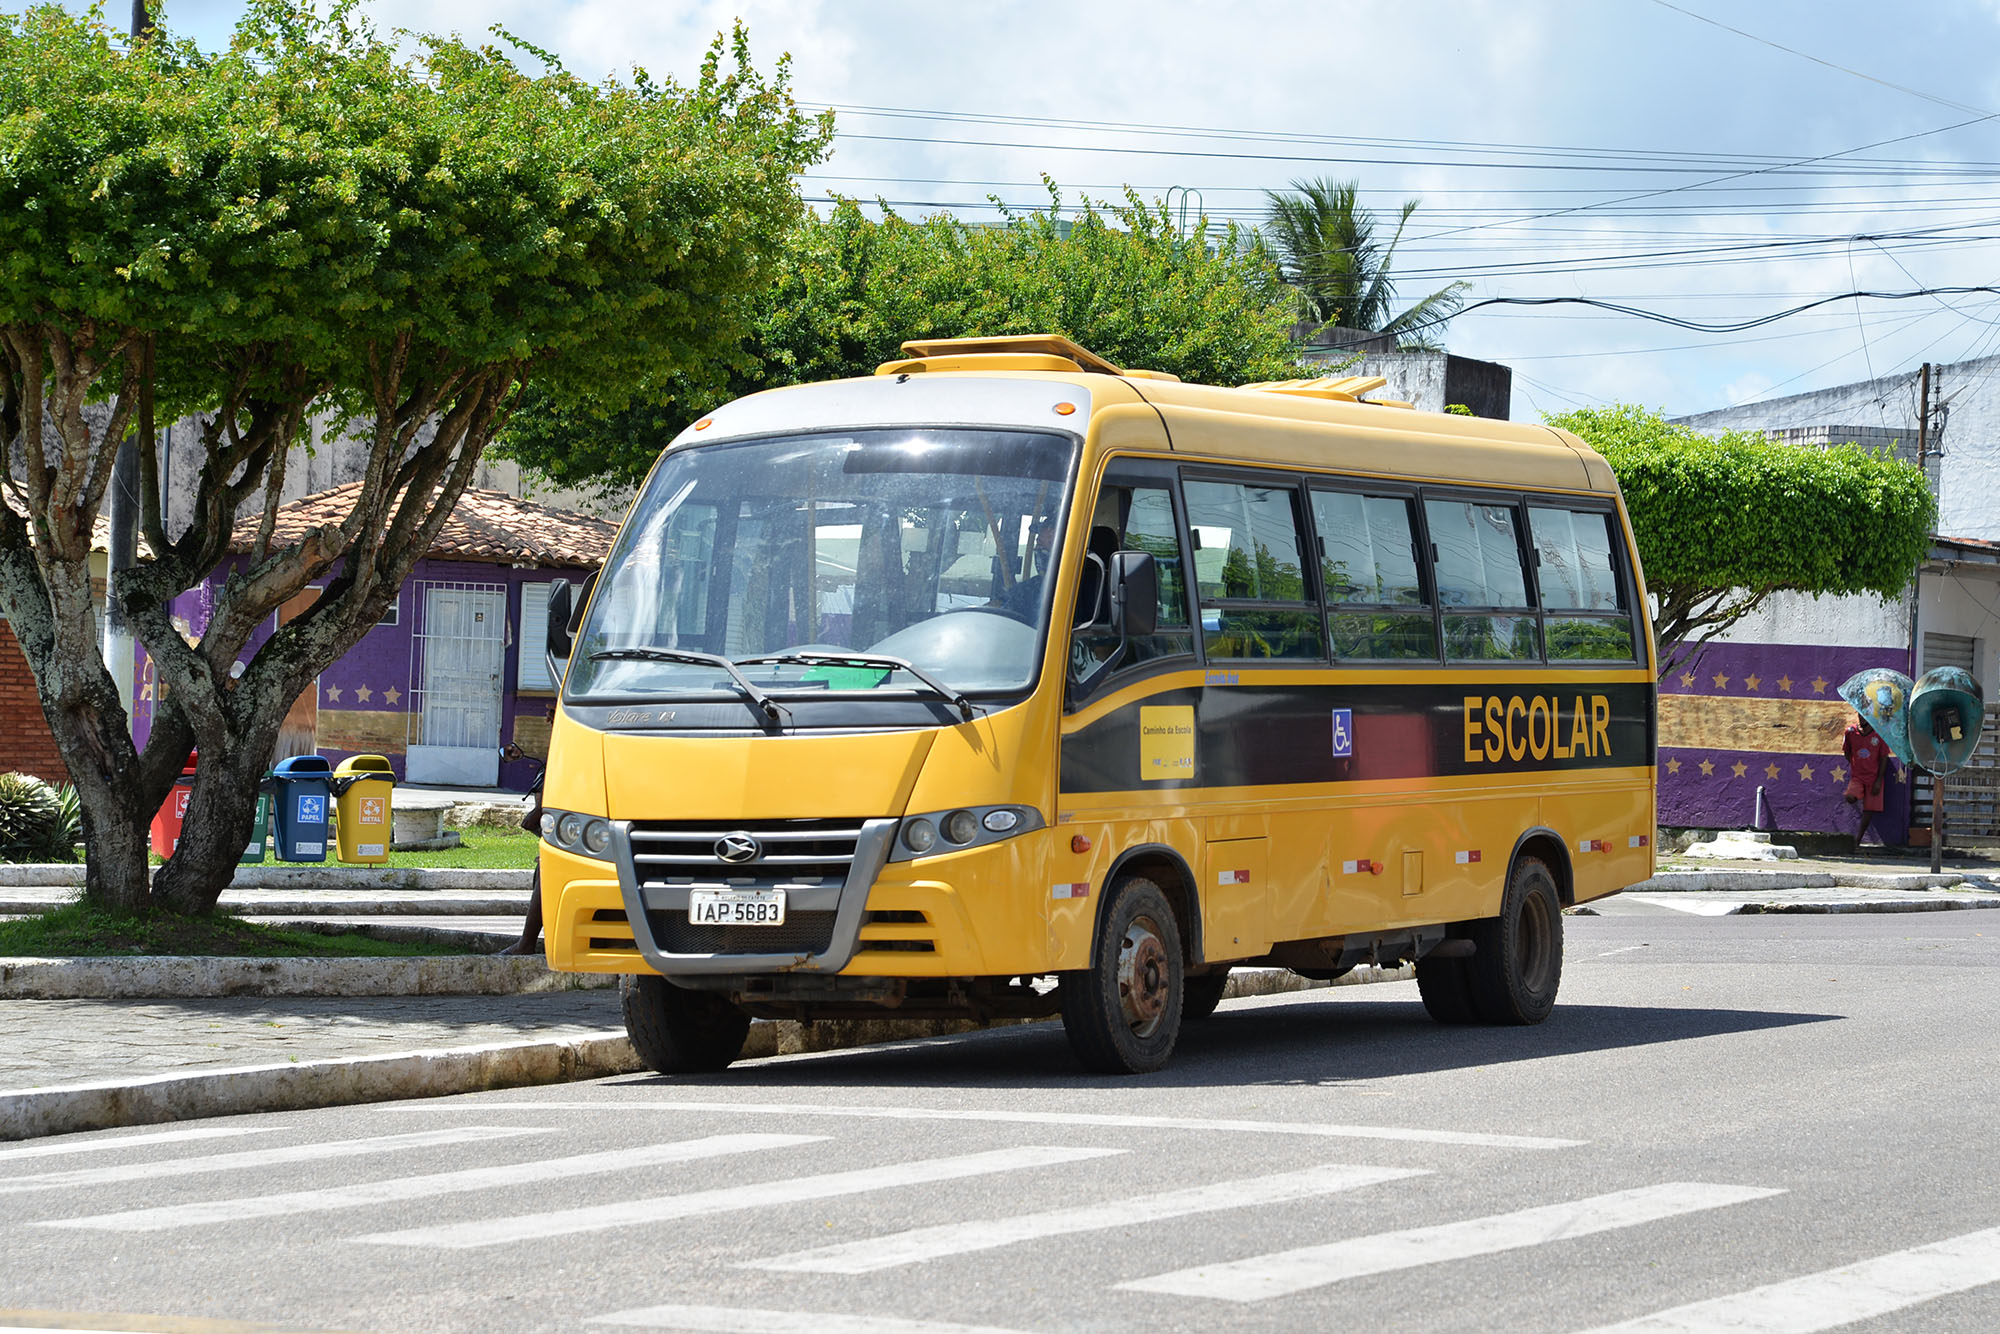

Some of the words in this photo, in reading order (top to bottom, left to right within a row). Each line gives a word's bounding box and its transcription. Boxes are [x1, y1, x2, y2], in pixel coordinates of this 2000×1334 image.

[607, 709, 651, 723] Volare
[1143, 726, 1166, 735] Caminho
[1167, 726, 1174, 734] da
[1175, 725, 1192, 734] Escola
[1464, 695, 1612, 763] ESCOLAR
[697, 903, 729, 921] IAP
[735, 903, 778, 921] 5683
